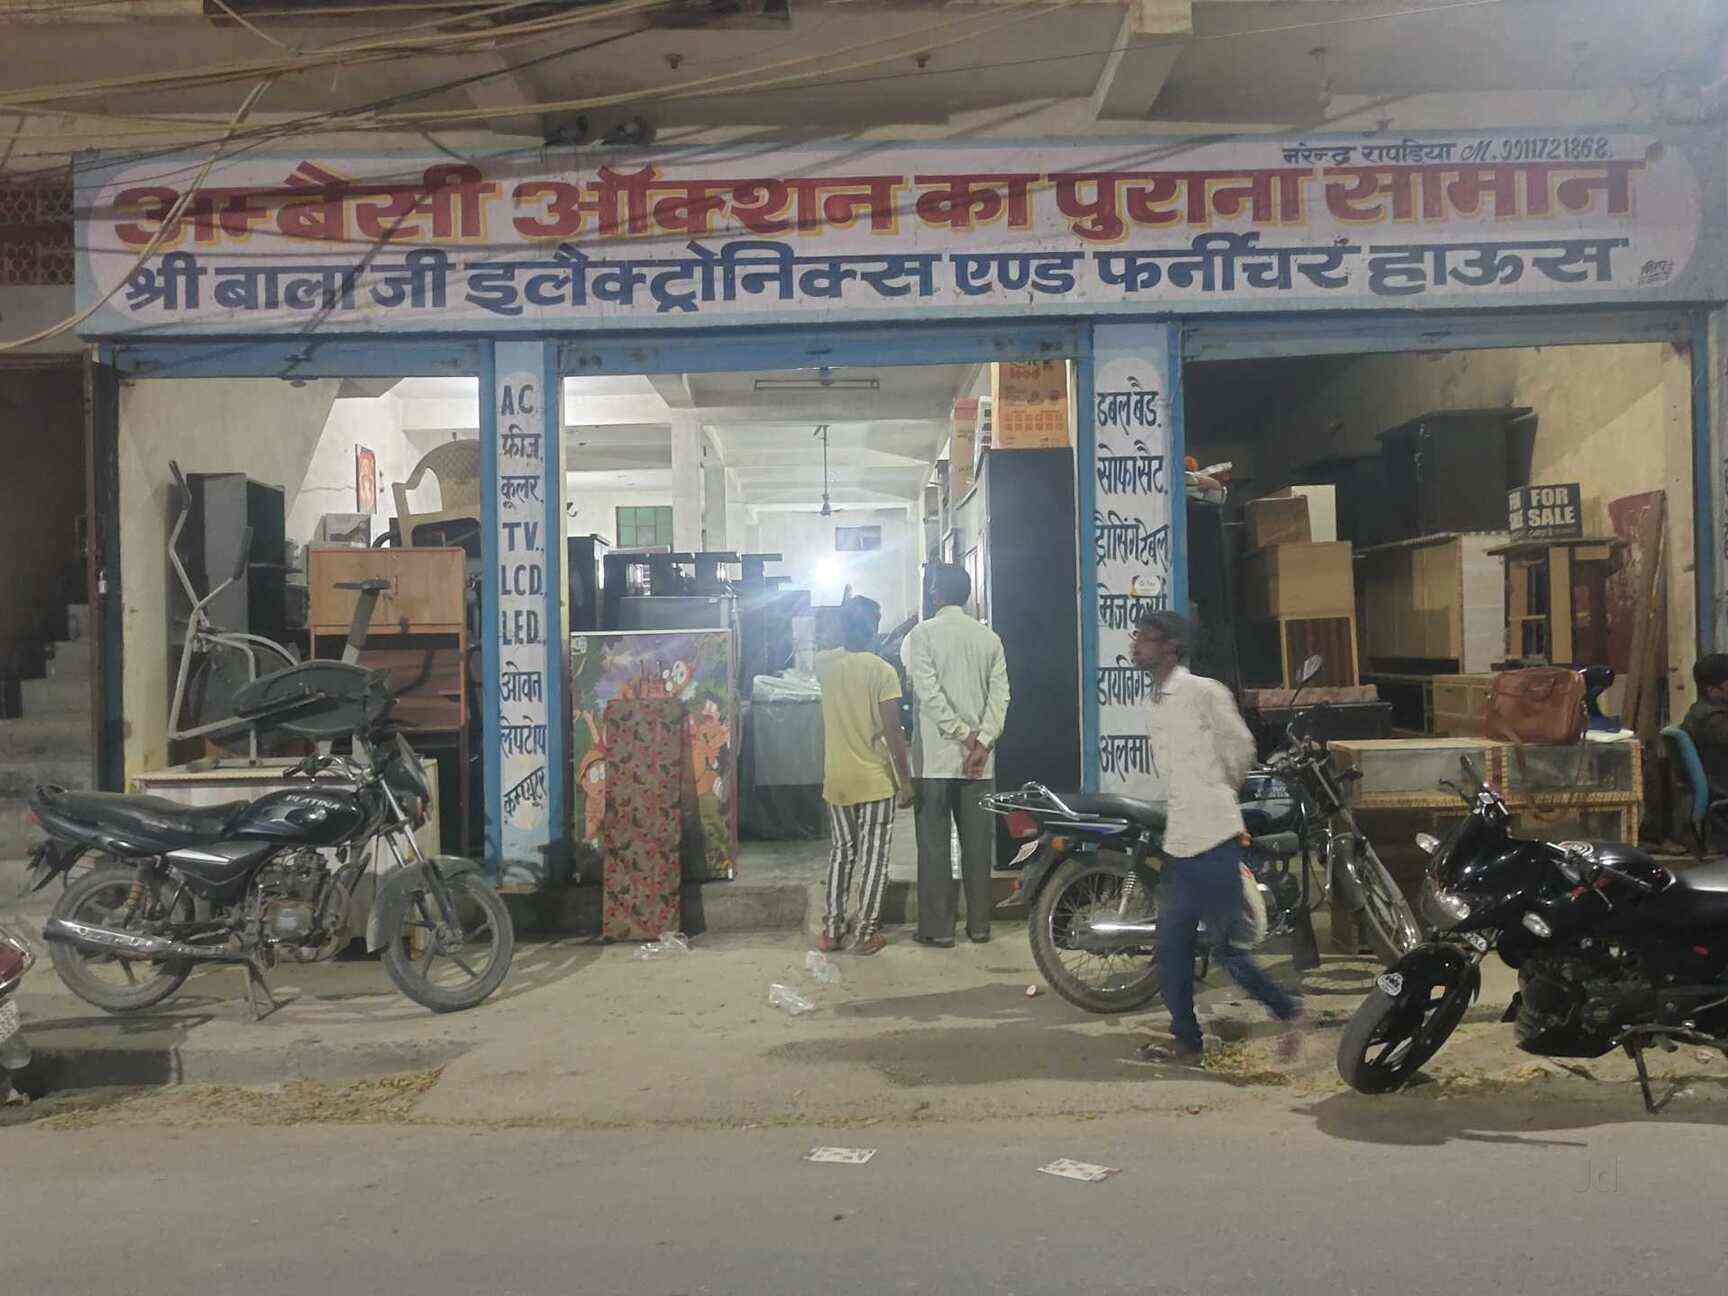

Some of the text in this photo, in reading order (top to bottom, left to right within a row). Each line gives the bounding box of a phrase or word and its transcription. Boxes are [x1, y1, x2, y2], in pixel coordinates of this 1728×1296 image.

[914, 173, 1040, 234] का
[1048, 166, 1314, 245] पुराना
[1323, 158, 1650, 224] सामान
[125, 250, 206, 312] श्री
[949, 251, 1086, 296] एण्ड
[1368, 236, 1630, 297] हाऊस
[1528, 506, 1575, 527] SALE
[1529, 488, 1568, 506] FOR
